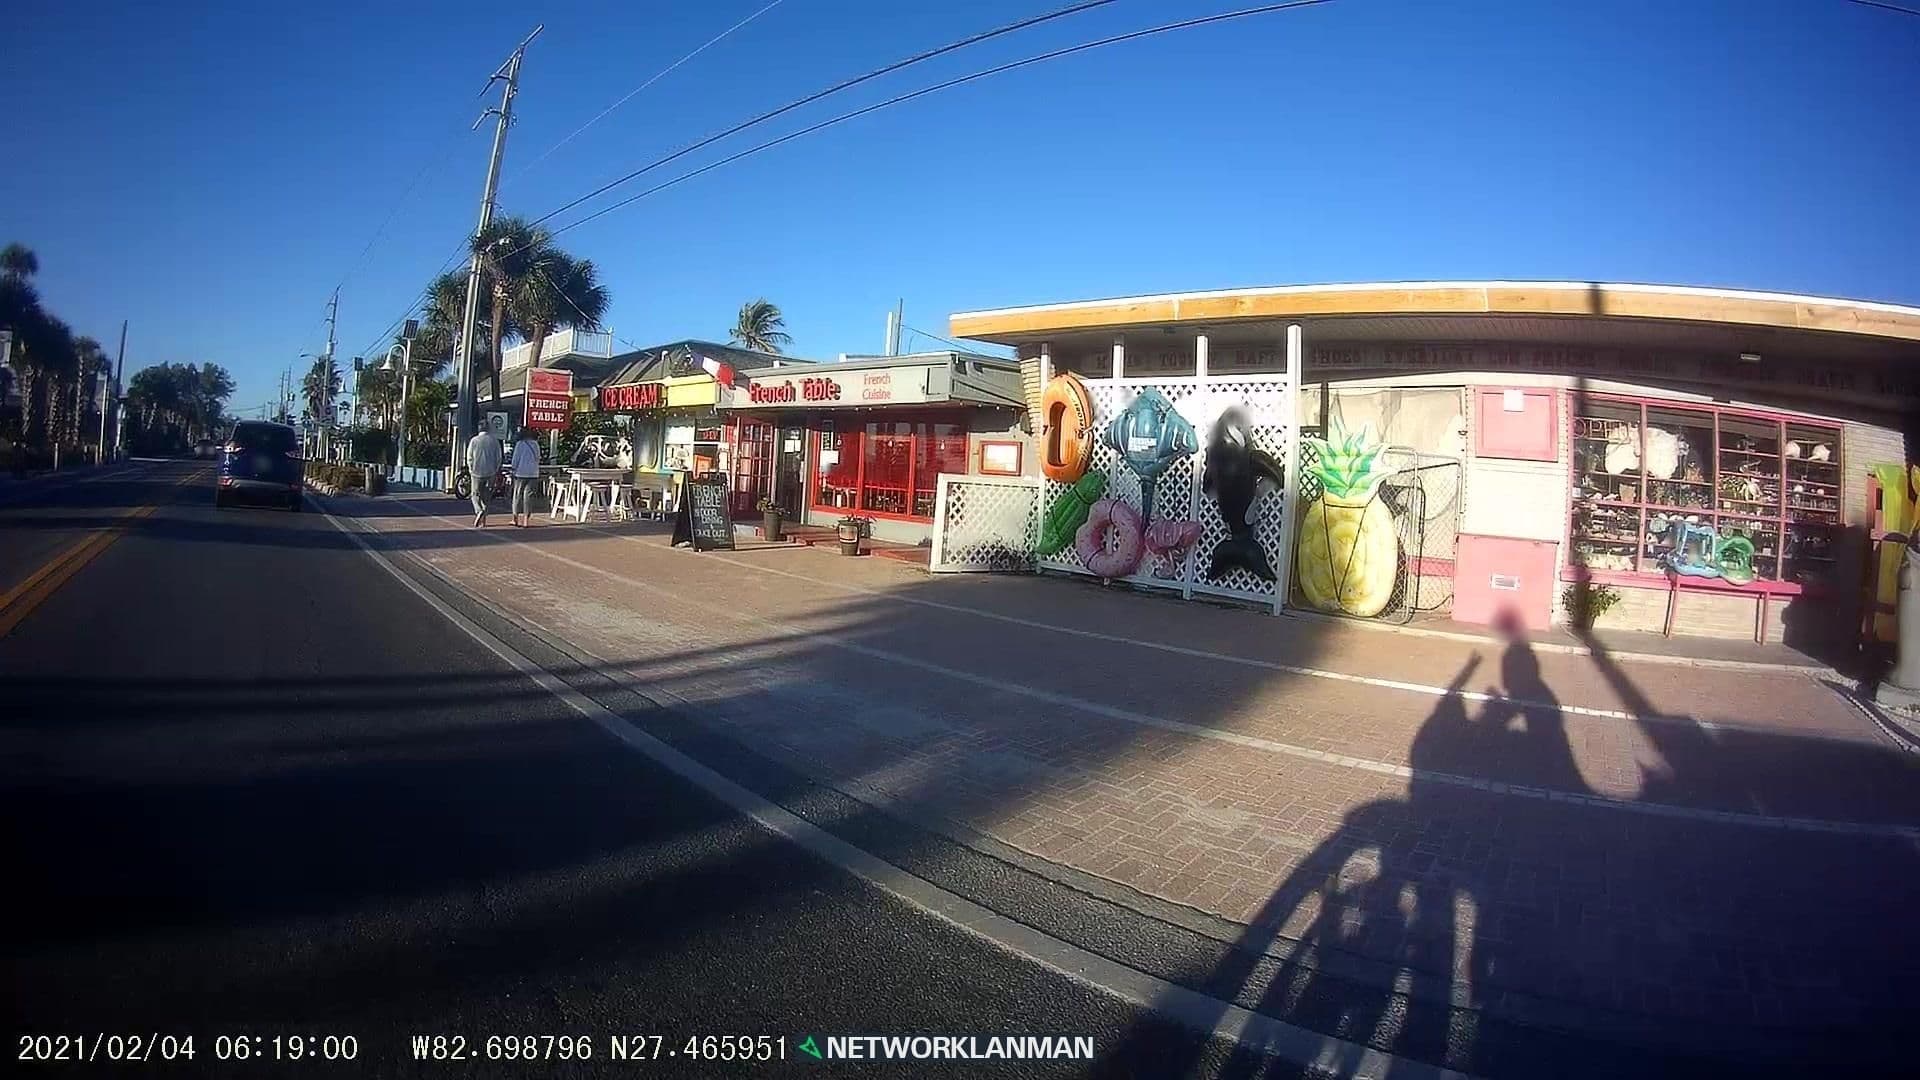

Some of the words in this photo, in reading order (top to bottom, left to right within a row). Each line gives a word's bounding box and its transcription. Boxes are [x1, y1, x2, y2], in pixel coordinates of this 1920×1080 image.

[864, 373, 891, 385] French
[601, 387, 618, 409] ICE
[620, 384, 657, 406] CREAM
[749, 380, 796, 403] French
[799, 378, 841, 401] Table
[529, 399, 568, 410] FRENCH
[531, 411, 565, 422] TABLE
